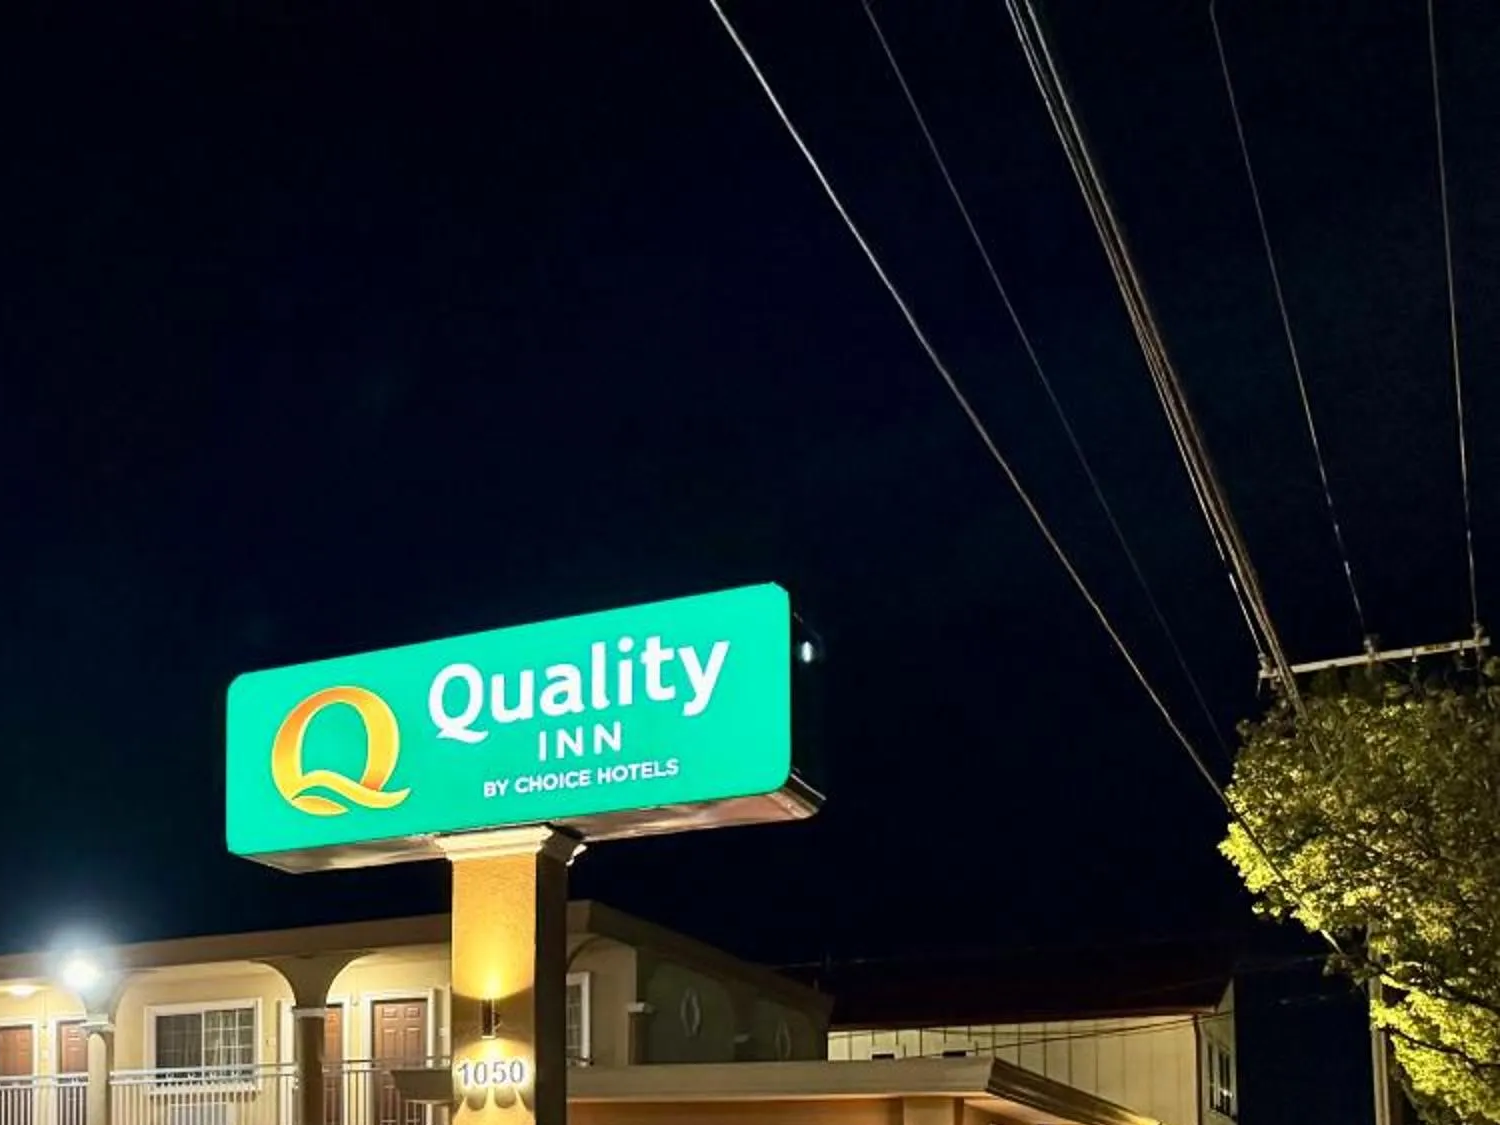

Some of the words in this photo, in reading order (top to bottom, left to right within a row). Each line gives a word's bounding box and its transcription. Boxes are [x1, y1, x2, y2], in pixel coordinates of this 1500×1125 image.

[428, 636, 729, 743] Quality
[271, 685, 411, 816] Q
[538, 721, 622, 761] INN
[484, 779, 509, 797] BY
[514, 768, 590, 795] CHOICE
[597, 758, 680, 784] HOTELS
[457, 1059, 525, 1086] 1050
